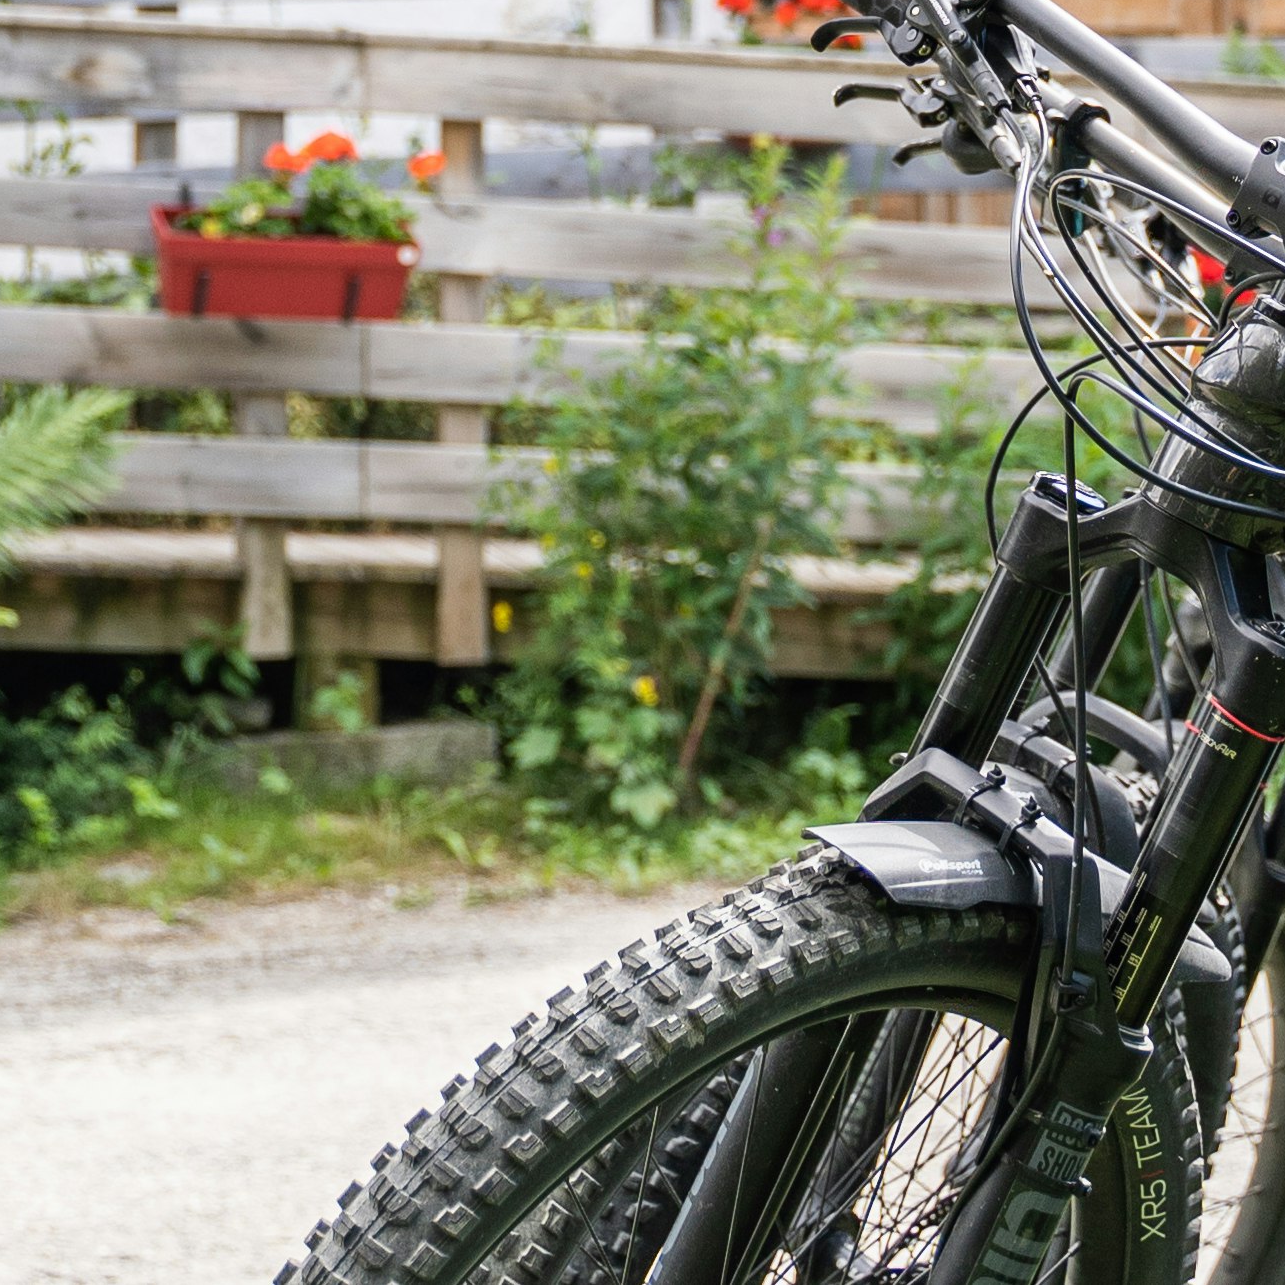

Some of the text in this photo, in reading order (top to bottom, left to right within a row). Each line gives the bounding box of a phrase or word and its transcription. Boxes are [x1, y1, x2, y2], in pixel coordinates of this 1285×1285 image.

[918, 858, 981, 873] Polisport
[1121, 1087, 1167, 1242] XR5 TEAM
